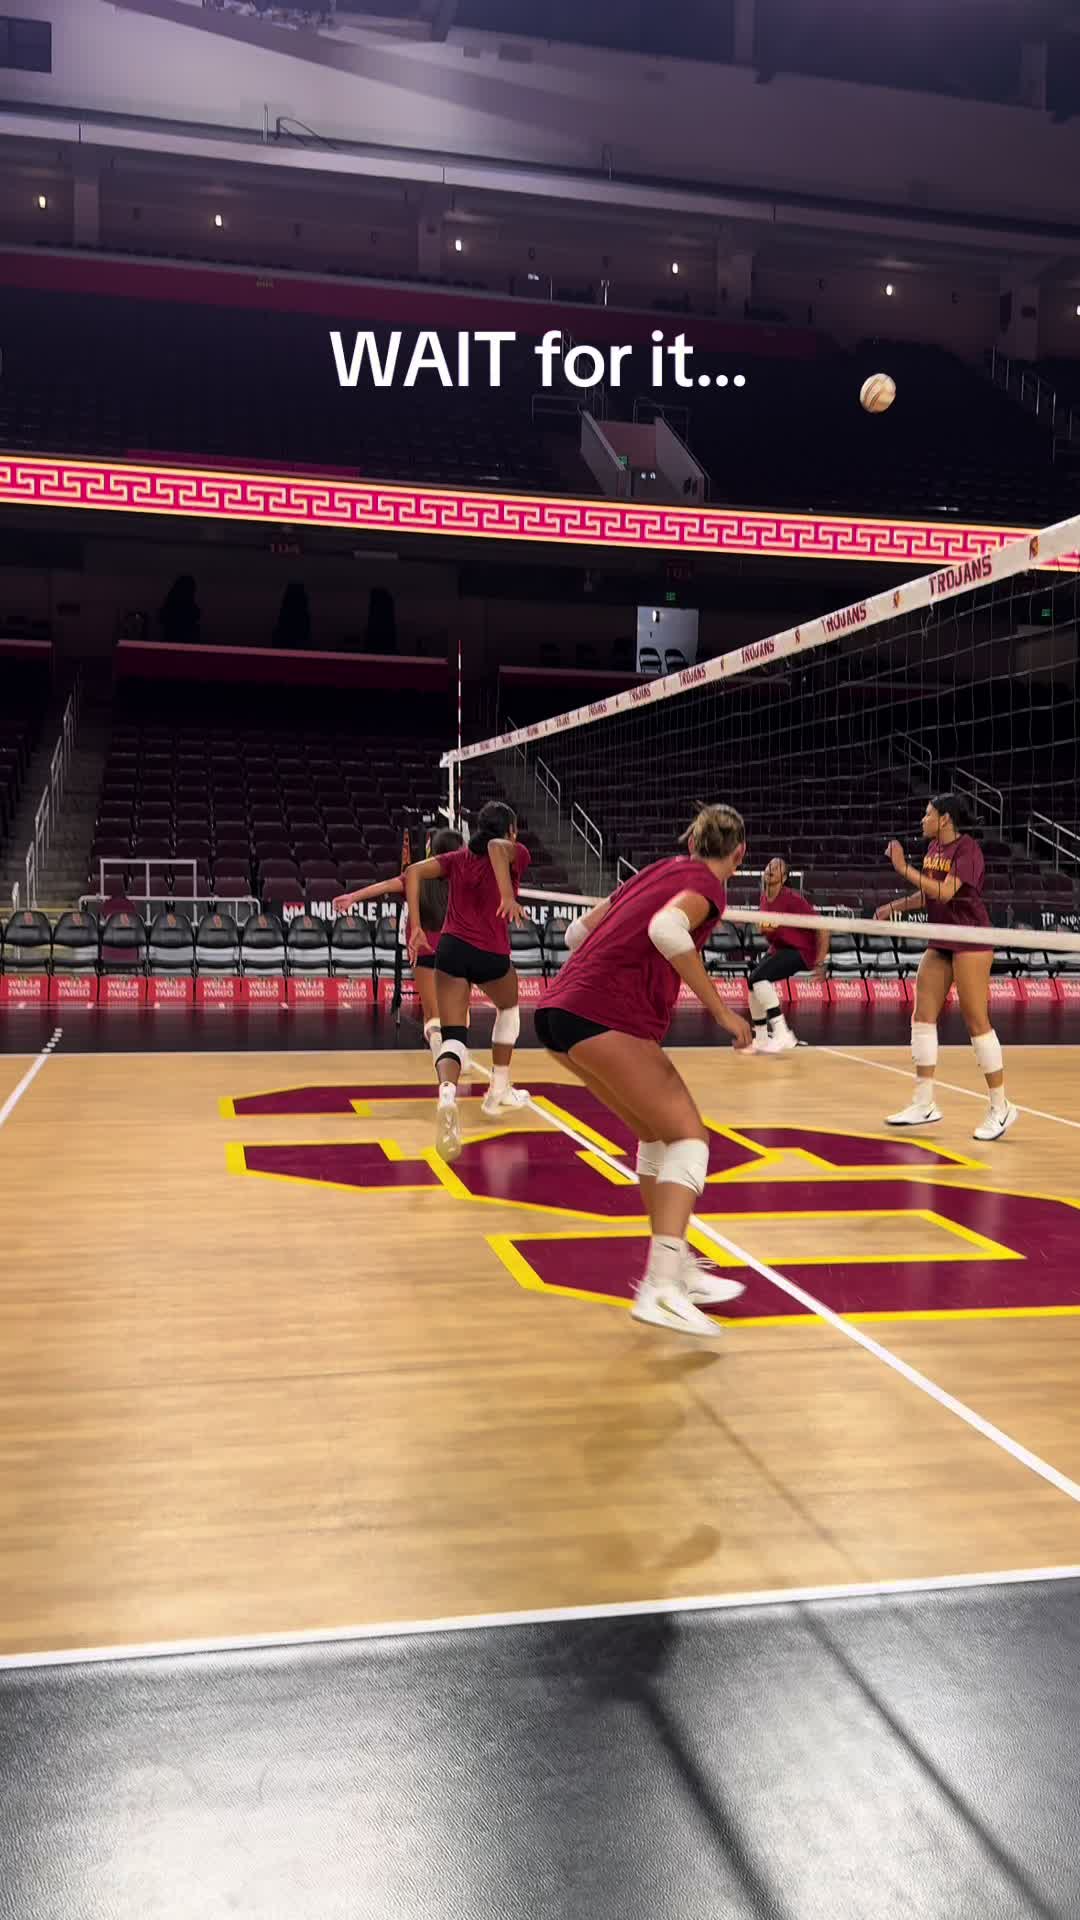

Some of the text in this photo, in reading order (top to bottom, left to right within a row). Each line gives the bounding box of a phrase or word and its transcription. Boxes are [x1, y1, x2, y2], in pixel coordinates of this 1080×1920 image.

[928, 555, 992, 596] TROJANS
[821, 603, 867, 634] TROJANS
[741, 640, 775, 664] TROJANS
[8, 980, 40, 988] WELLS
[57, 980, 90, 988] WELLS
[107, 981, 139, 989] WELLS
[155, 981, 186, 989] WELLS
[203, 981, 234, 989] WELLS
[248, 981, 279, 989] WELLS
[294, 981, 324, 989] WELLS
[337, 982, 366, 990] WELLS
[8, 989, 40, 997] FARGO
[58, 989, 90, 997] FARGO
[108, 990, 139, 998] FARGO
[156, 989, 186, 998] FARGO
[204, 990, 234, 998] FARGO
[249, 990, 279, 998] FARGO
[295, 990, 325, 998] FARGO
[338, 990, 367, 998] FARGO
